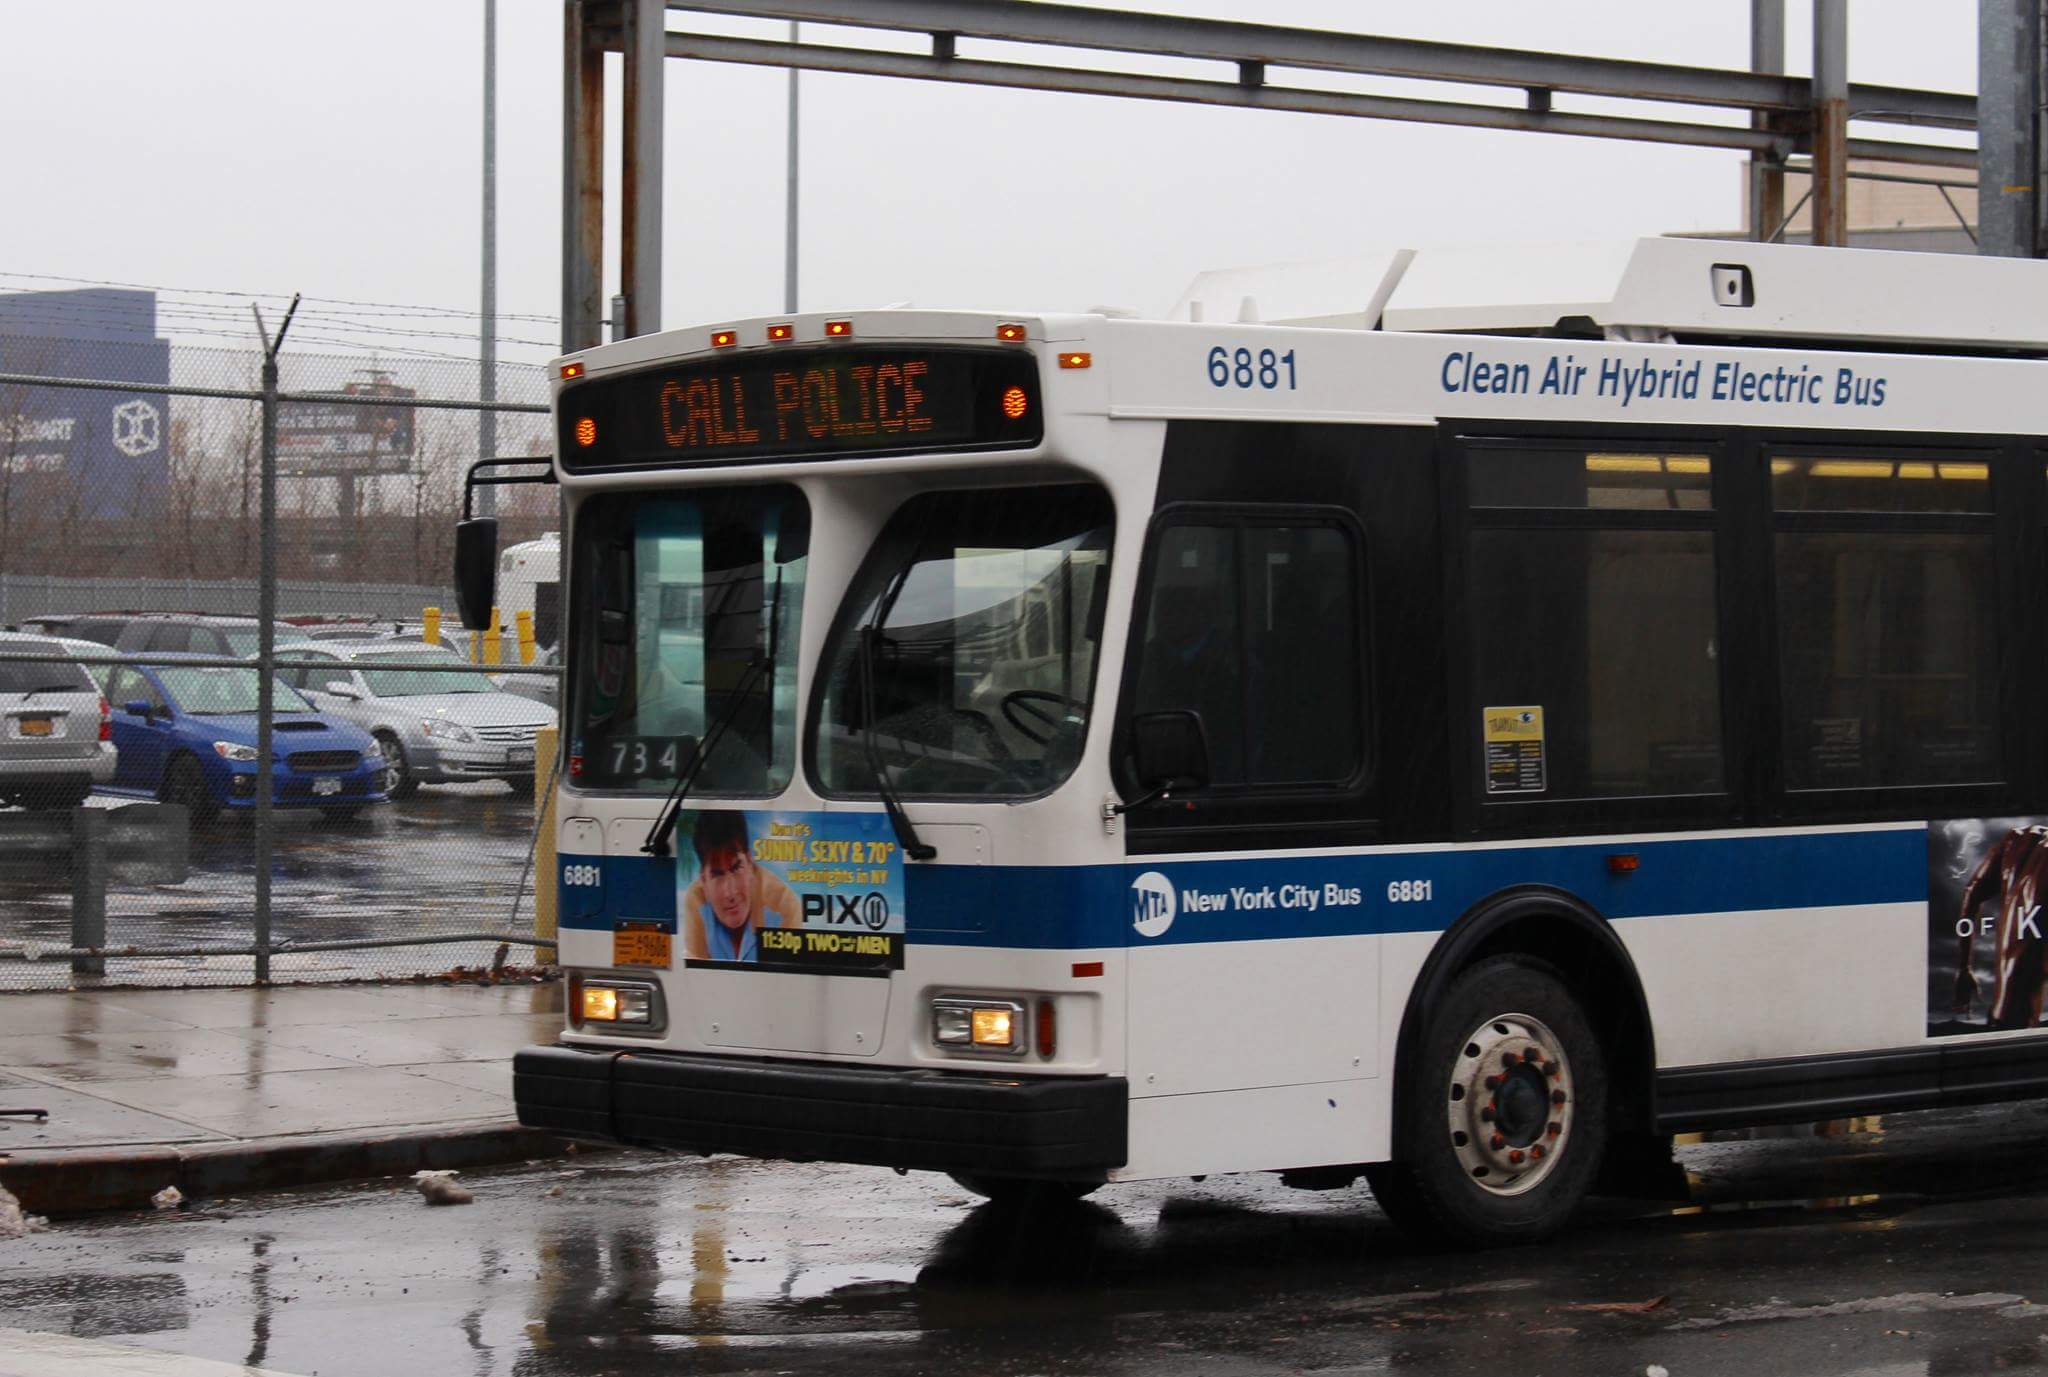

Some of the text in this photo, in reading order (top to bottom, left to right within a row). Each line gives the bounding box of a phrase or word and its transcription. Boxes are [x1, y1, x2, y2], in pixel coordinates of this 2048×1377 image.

[1207, 345, 1296, 390] 6881
[1441, 351, 1888, 408] Clean Air Hybrid Electric Bus
[660, 360, 932, 447] CALL POLICE
[611, 741, 678, 774] 734
[810, 840, 850, 863] SEXY
[851, 841, 865, 864] &
[564, 865, 600, 887] 6881
[1182, 889, 1228, 913] New
[1231, 885, 1276, 911] York
[1279, 884, 1320, 912] City
[1324, 883, 1362, 906] Bus
[1387, 879, 1433, 903] 6881
[1955, 916, 1995, 937] OF
[762, 930, 802, 955] 11:30p
[806, 933, 840, 953] TWO
[856, 936, 891, 955] MEN
